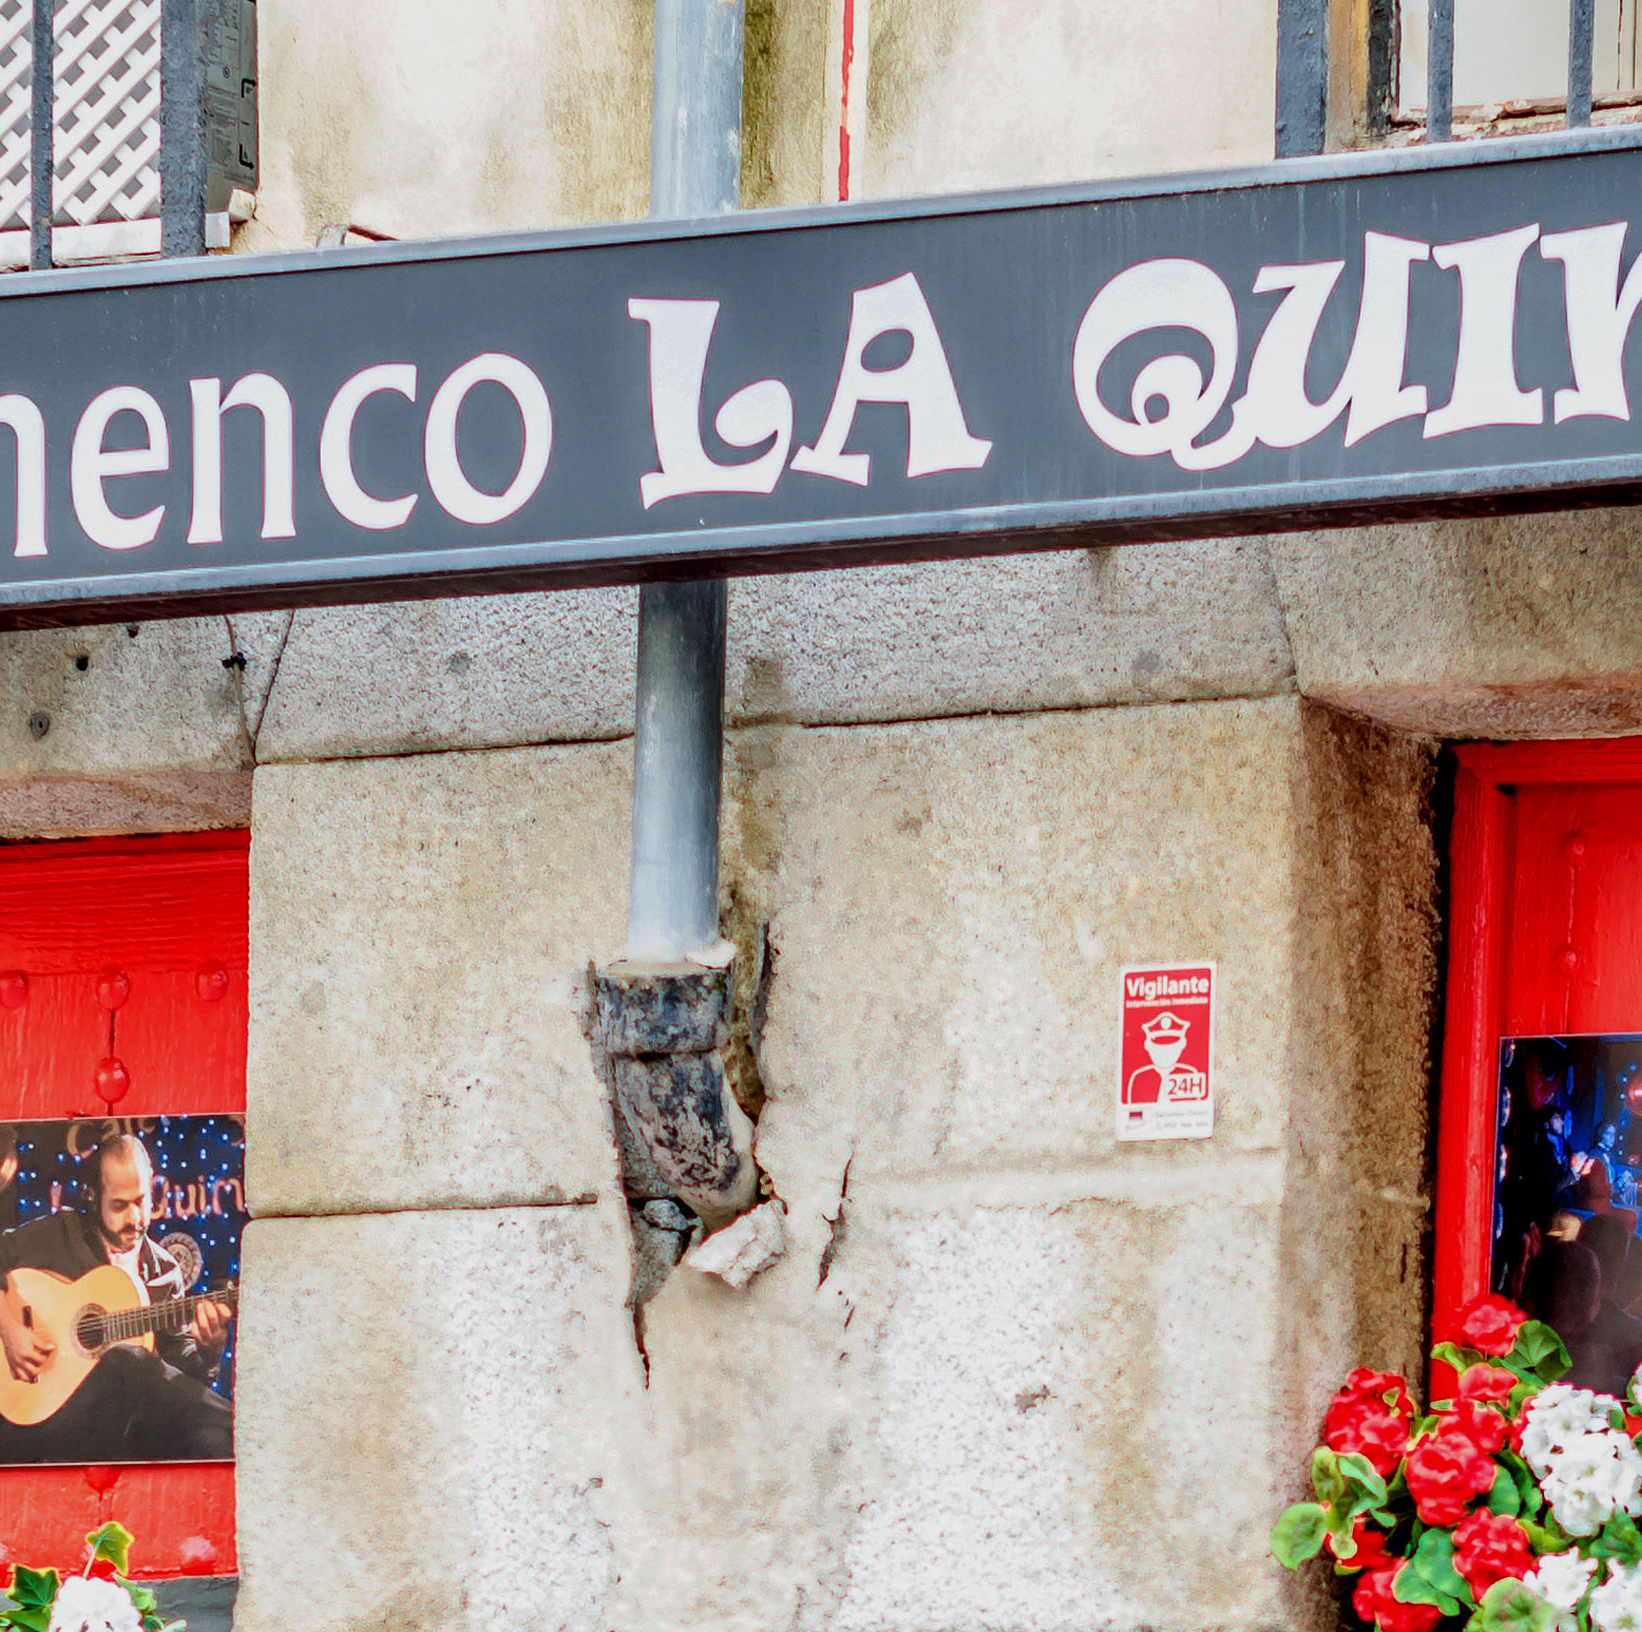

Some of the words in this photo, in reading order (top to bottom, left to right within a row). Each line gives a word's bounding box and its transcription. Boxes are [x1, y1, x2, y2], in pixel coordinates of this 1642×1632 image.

[627, 272, 993, 508] LA
[1126, 975, 1210, 1001] Vigilante
[1168, 1078, 1203, 1096] 24H
